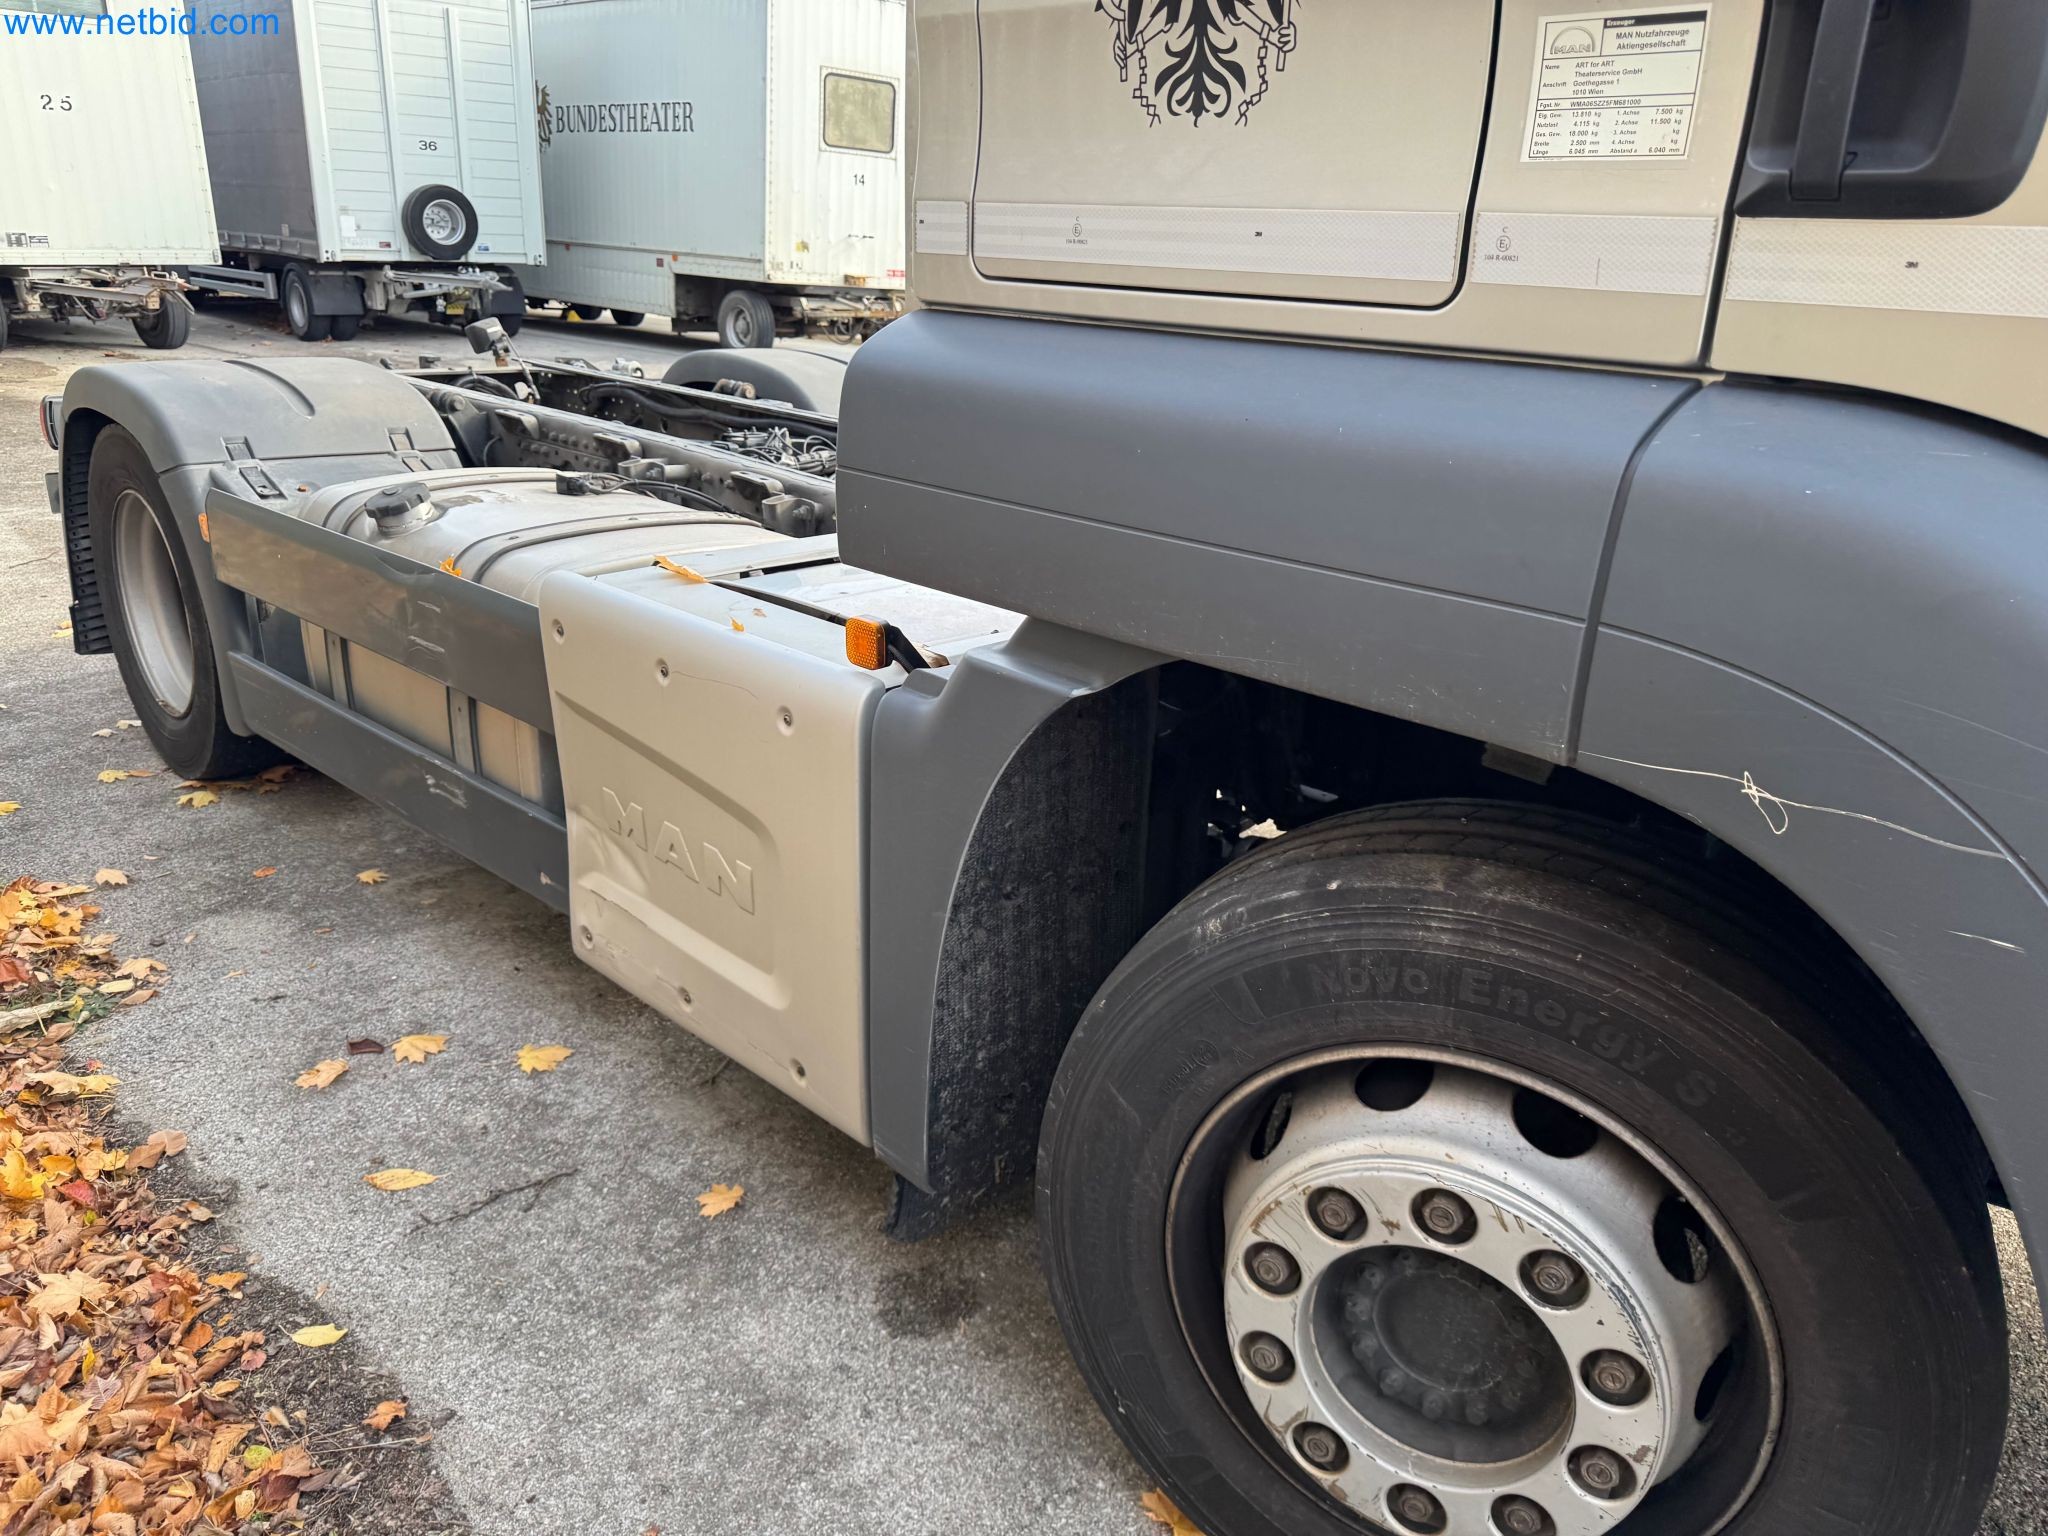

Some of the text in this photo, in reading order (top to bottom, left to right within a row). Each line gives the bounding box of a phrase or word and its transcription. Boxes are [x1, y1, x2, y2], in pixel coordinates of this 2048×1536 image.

[1606, 18, 1636, 27] Erzeuger
[1615, 28, 1690, 40] MAN Nutzfahrzeuge
[1553, 43, 1593, 54] MAN
[1616, 39, 1686, 51] Aktiengesellschaft
[1621, 67, 1643, 75] GmbH
[1573, 79, 1614, 87] Goethegasse
[1675, 107, 1684, 115] kg
[555, 101, 695, 134] BUNDESTHEATER
[1650, 117, 1672, 125] 11.500
[1672, 127, 1680, 135] kg
[418, 139, 438, 151] 36
[852, 173, 866, 186] 14
[602, 786, 756, 916] MAN
[1457, 966, 1666, 1076] Energy
